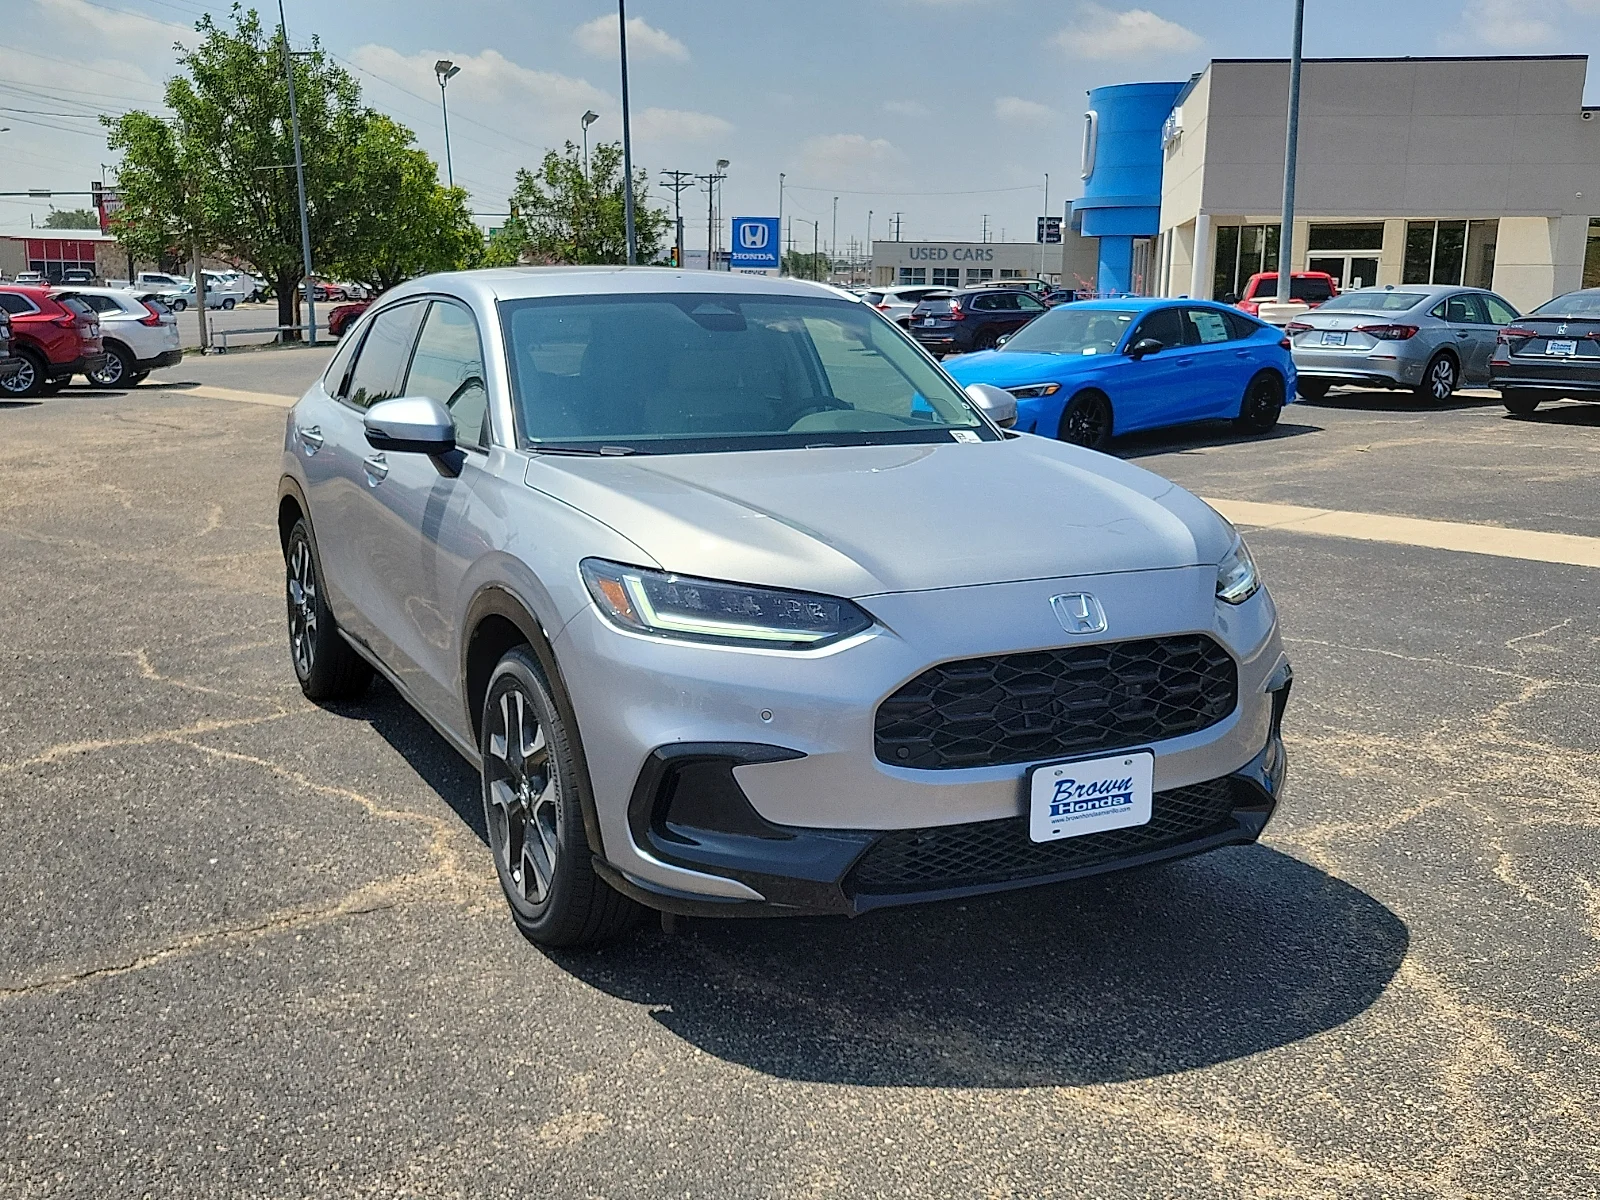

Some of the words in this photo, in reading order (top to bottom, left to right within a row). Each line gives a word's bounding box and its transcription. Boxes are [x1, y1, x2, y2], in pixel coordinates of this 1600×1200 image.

[732, 252, 775, 260] HONDA
[909, 247, 948, 260] USED
[952, 248, 994, 261] CARS
[1051, 776, 1133, 803] Brown
[1058, 795, 1125, 815] Honda
